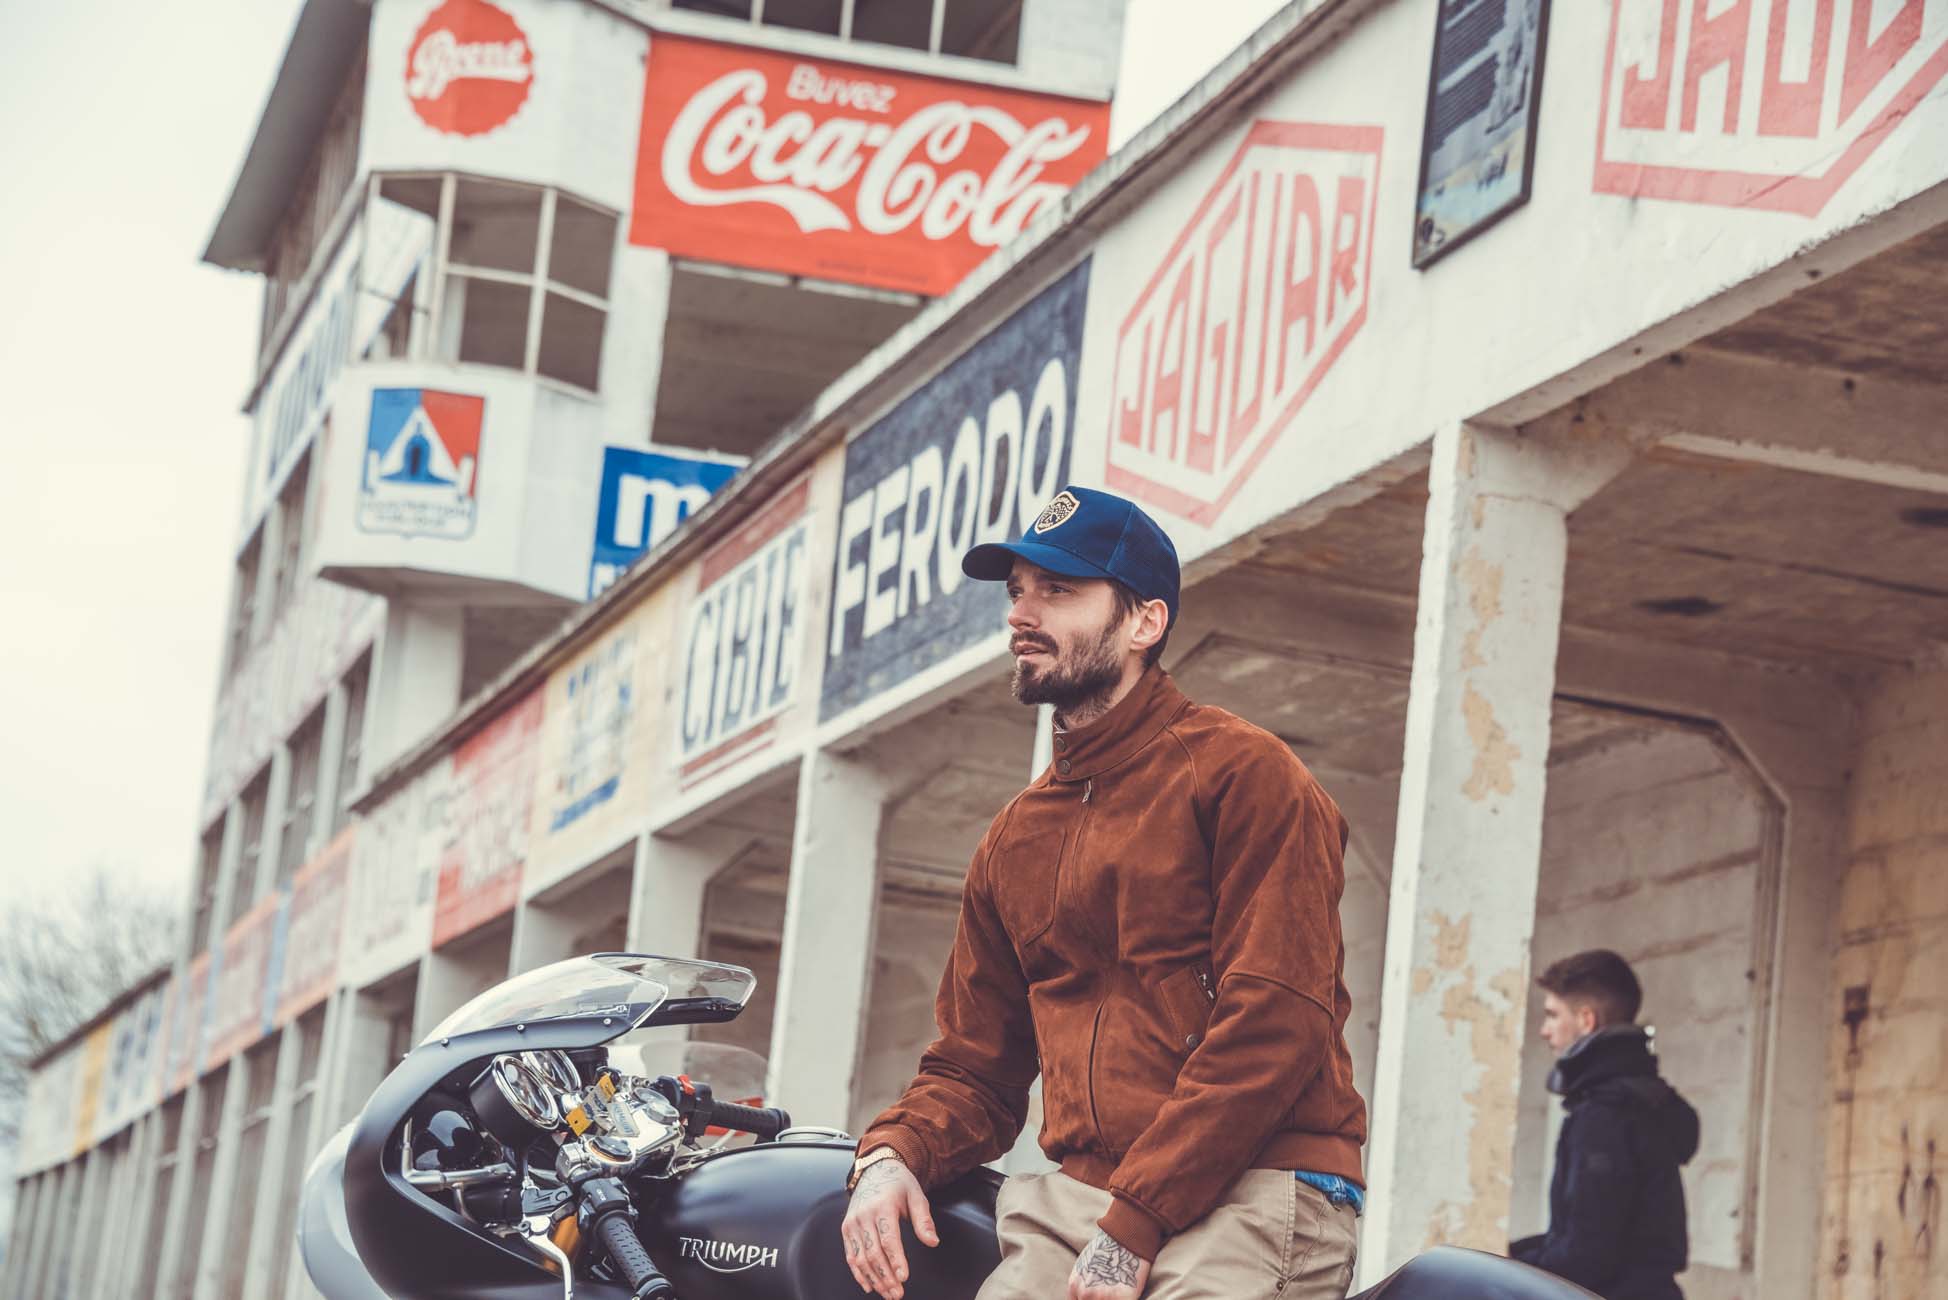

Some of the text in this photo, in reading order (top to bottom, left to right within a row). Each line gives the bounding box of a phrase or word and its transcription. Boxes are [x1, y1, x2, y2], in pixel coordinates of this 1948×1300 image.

[786, 63, 898, 114] Buvez
[1117, 169, 1367, 476] JAGUAR
[829, 357, 1068, 657] FERODO
[680, 1236, 779, 1271] TRIUMPH
